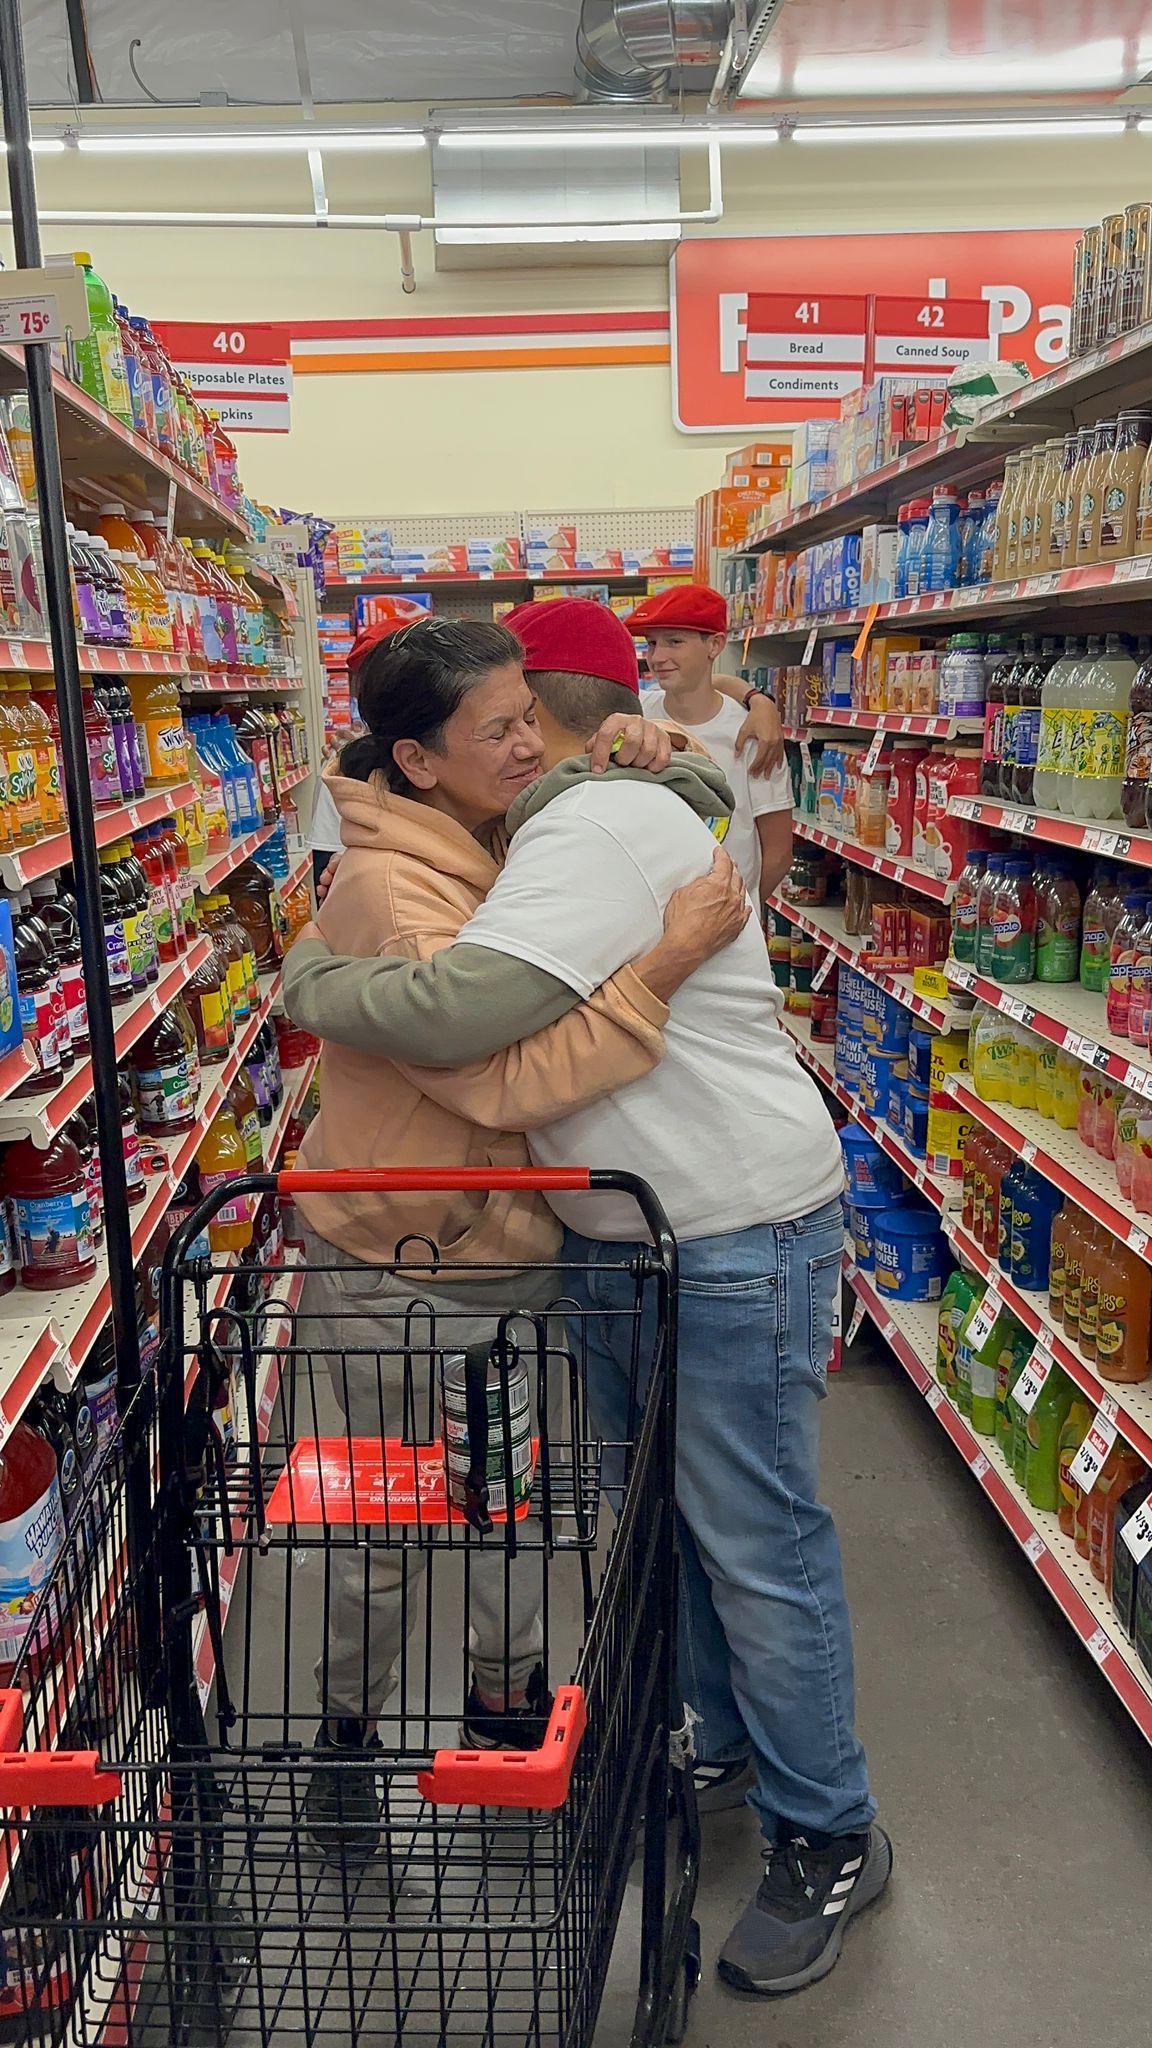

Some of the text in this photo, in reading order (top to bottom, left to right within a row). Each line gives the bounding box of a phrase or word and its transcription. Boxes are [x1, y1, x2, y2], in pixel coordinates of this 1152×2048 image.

[795, 302, 819, 323] 41
[917, 306, 944, 327] 42
[213, 331, 246, 354] 40
[789, 342, 823, 354] Bread
[896, 345, 970, 359] Canned Soup
[248, 373, 285, 385] Plates
[769, 378, 839, 391] Condiments
[204, 408, 253, 421] pkins
[1091, 1431, 1106, 1454] Sale!
